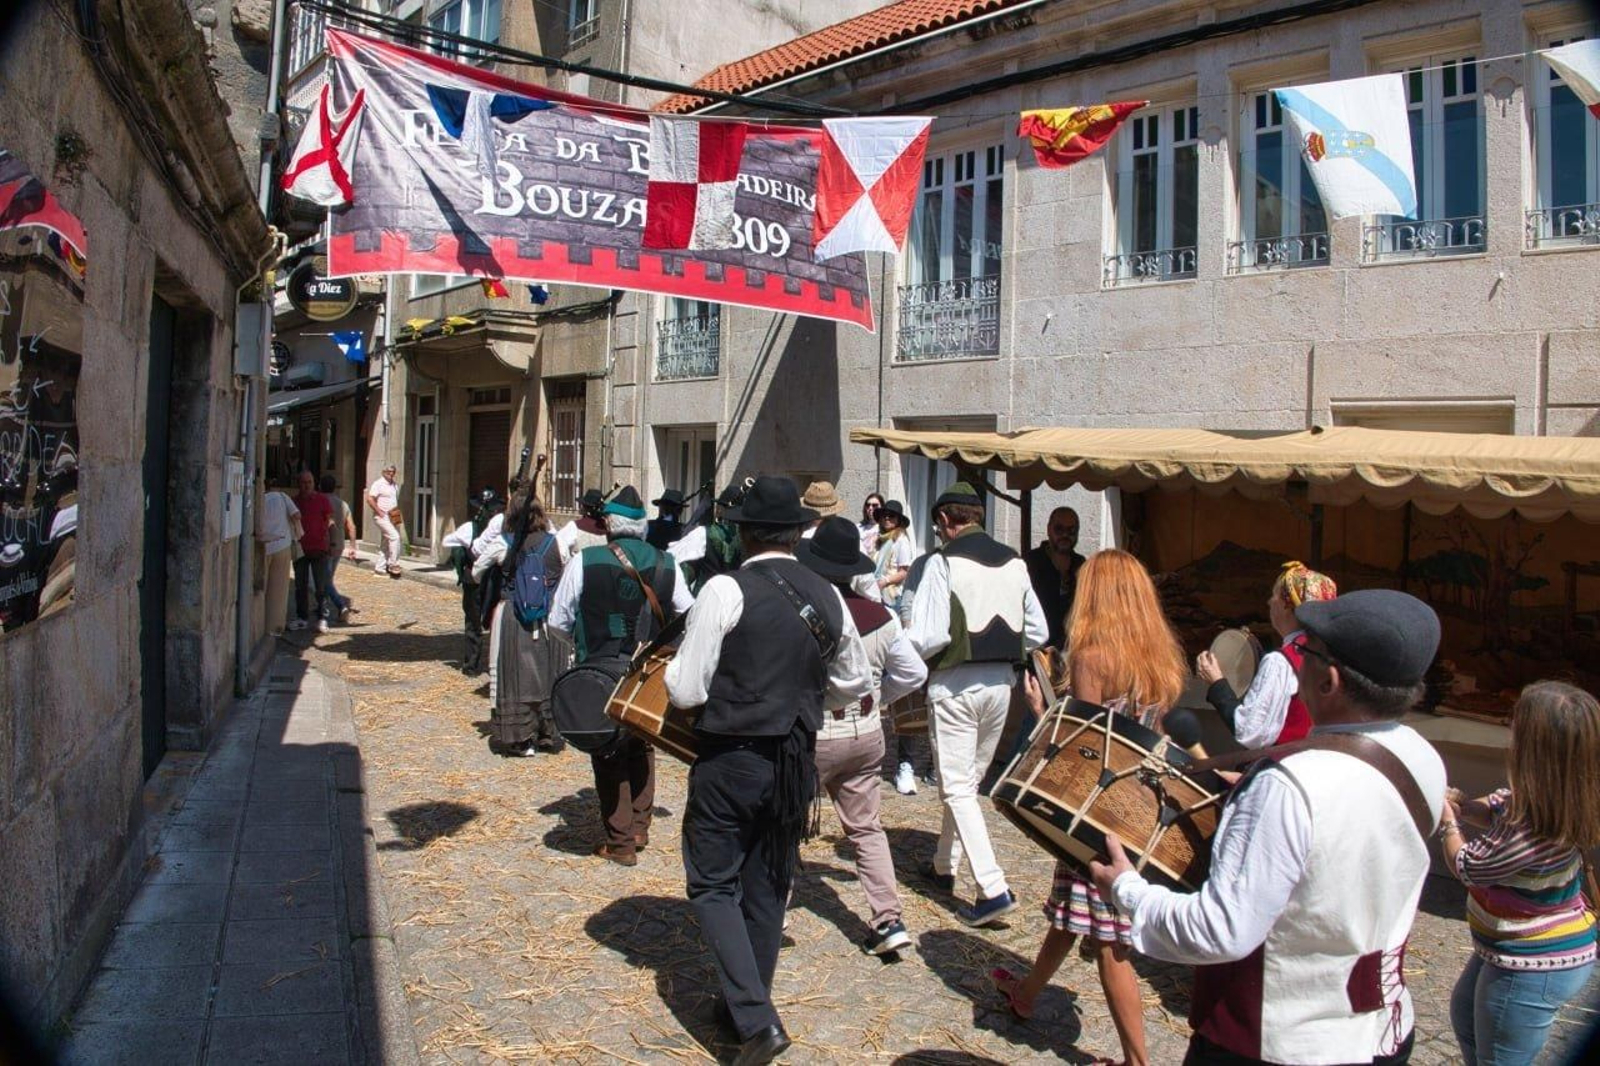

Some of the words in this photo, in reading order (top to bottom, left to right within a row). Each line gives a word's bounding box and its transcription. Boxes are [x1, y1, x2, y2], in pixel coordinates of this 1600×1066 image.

[399, 109, 529, 152] FEA
[554, 136, 602, 163] DA
[318, 281, 342, 294] Diez
